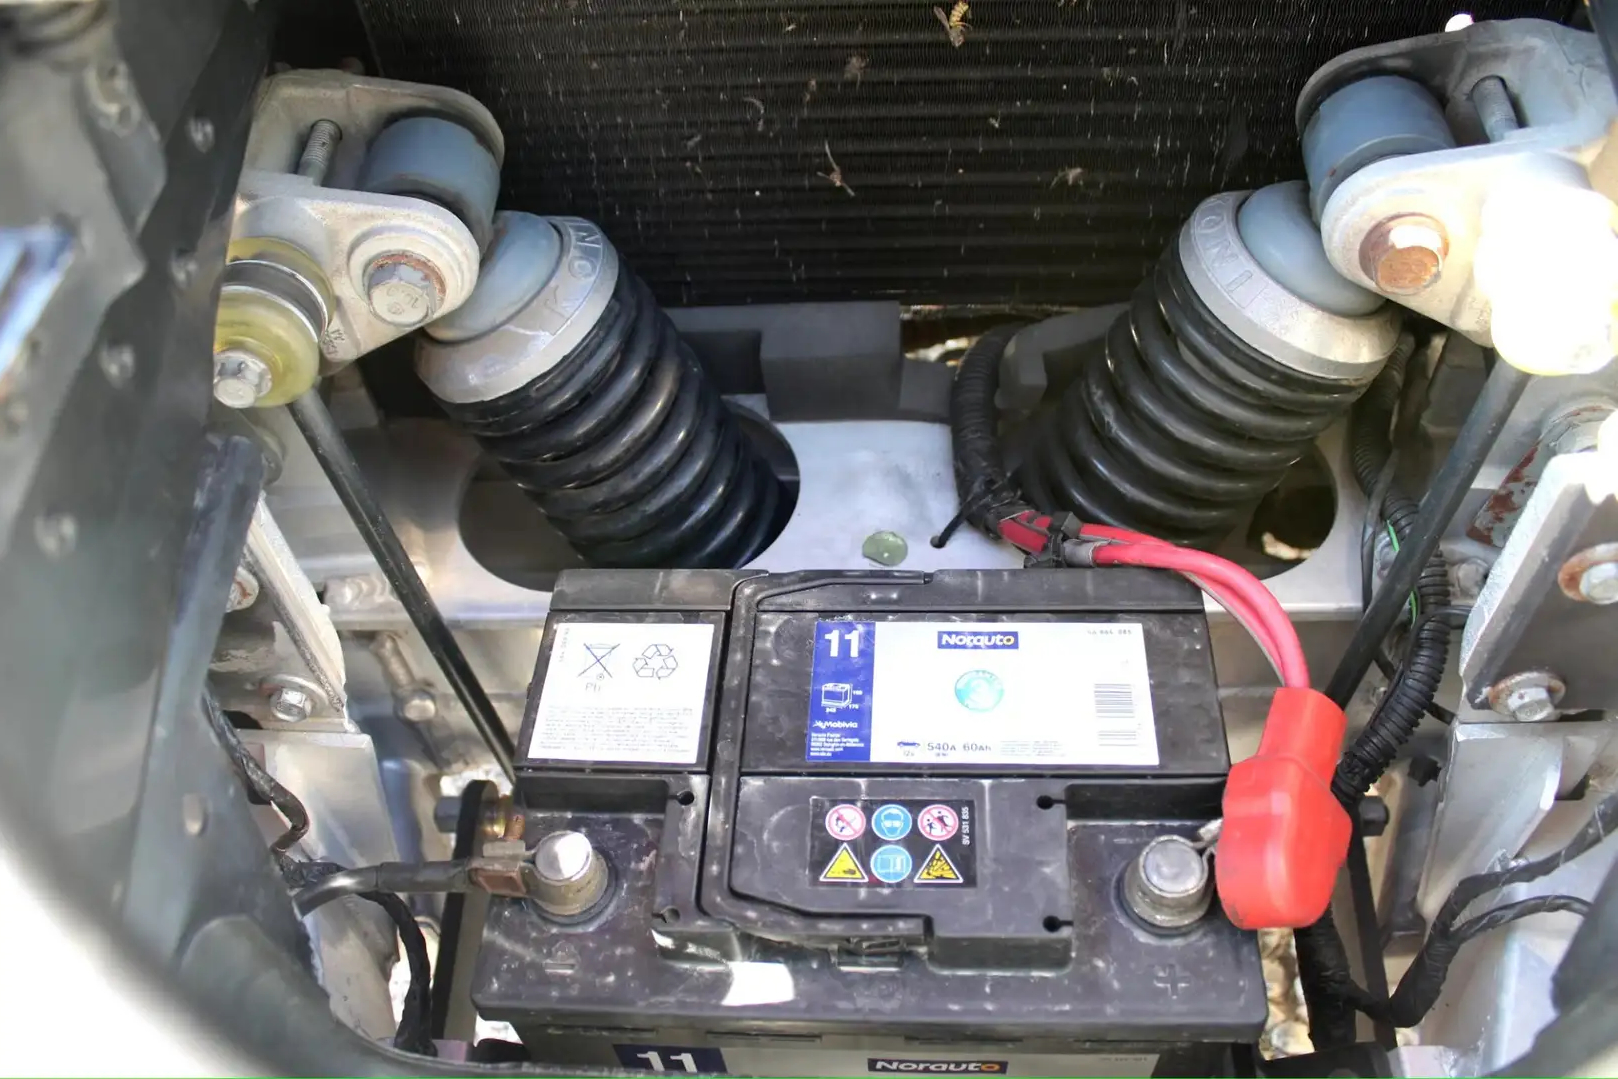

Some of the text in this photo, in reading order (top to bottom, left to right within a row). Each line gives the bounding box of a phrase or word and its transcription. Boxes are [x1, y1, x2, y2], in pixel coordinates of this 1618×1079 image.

[824, 629, 860, 658] 11
[940, 633, 1015, 648] Norauto
[637, 1051, 698, 1073] 11
[875, 1061, 1000, 1072] Norauto
